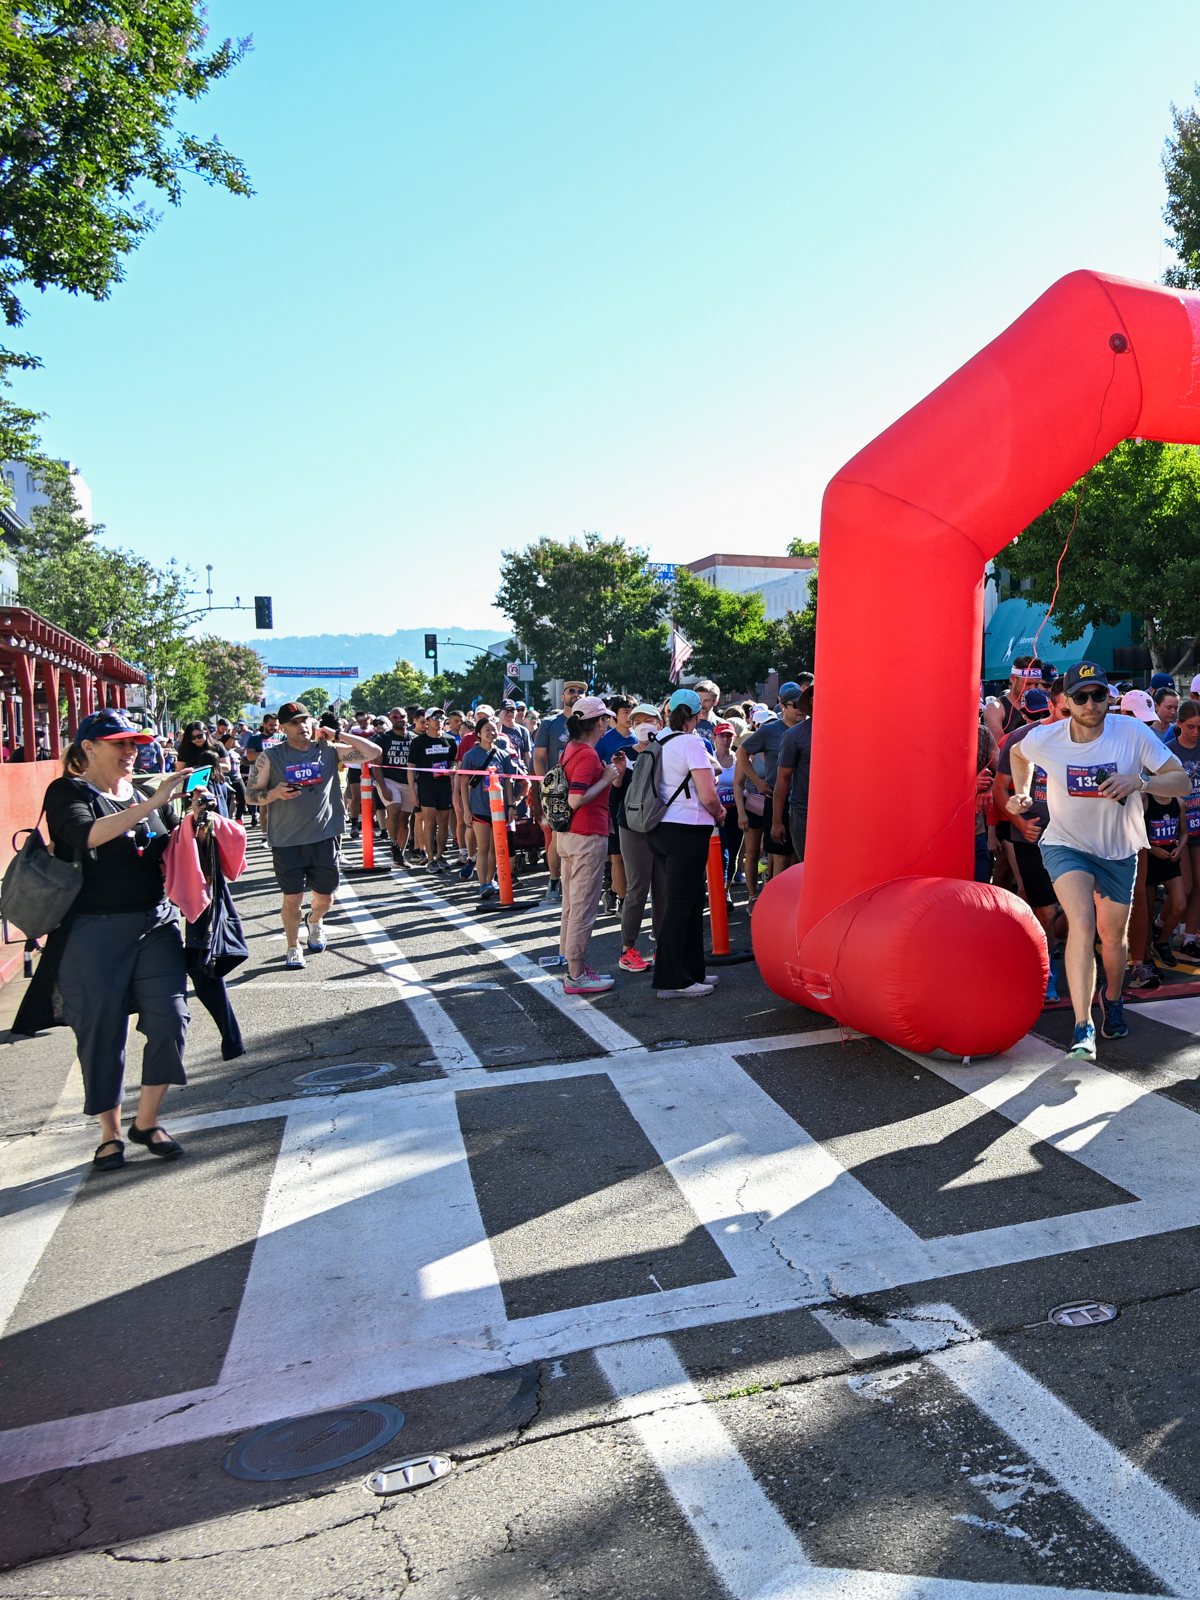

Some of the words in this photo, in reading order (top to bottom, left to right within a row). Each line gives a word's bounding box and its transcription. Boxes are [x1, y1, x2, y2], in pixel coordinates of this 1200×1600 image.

[1079, 665, 1097, 679] Cal
[295, 769, 312, 779] 670
[1156, 826, 1176, 837] 1117
